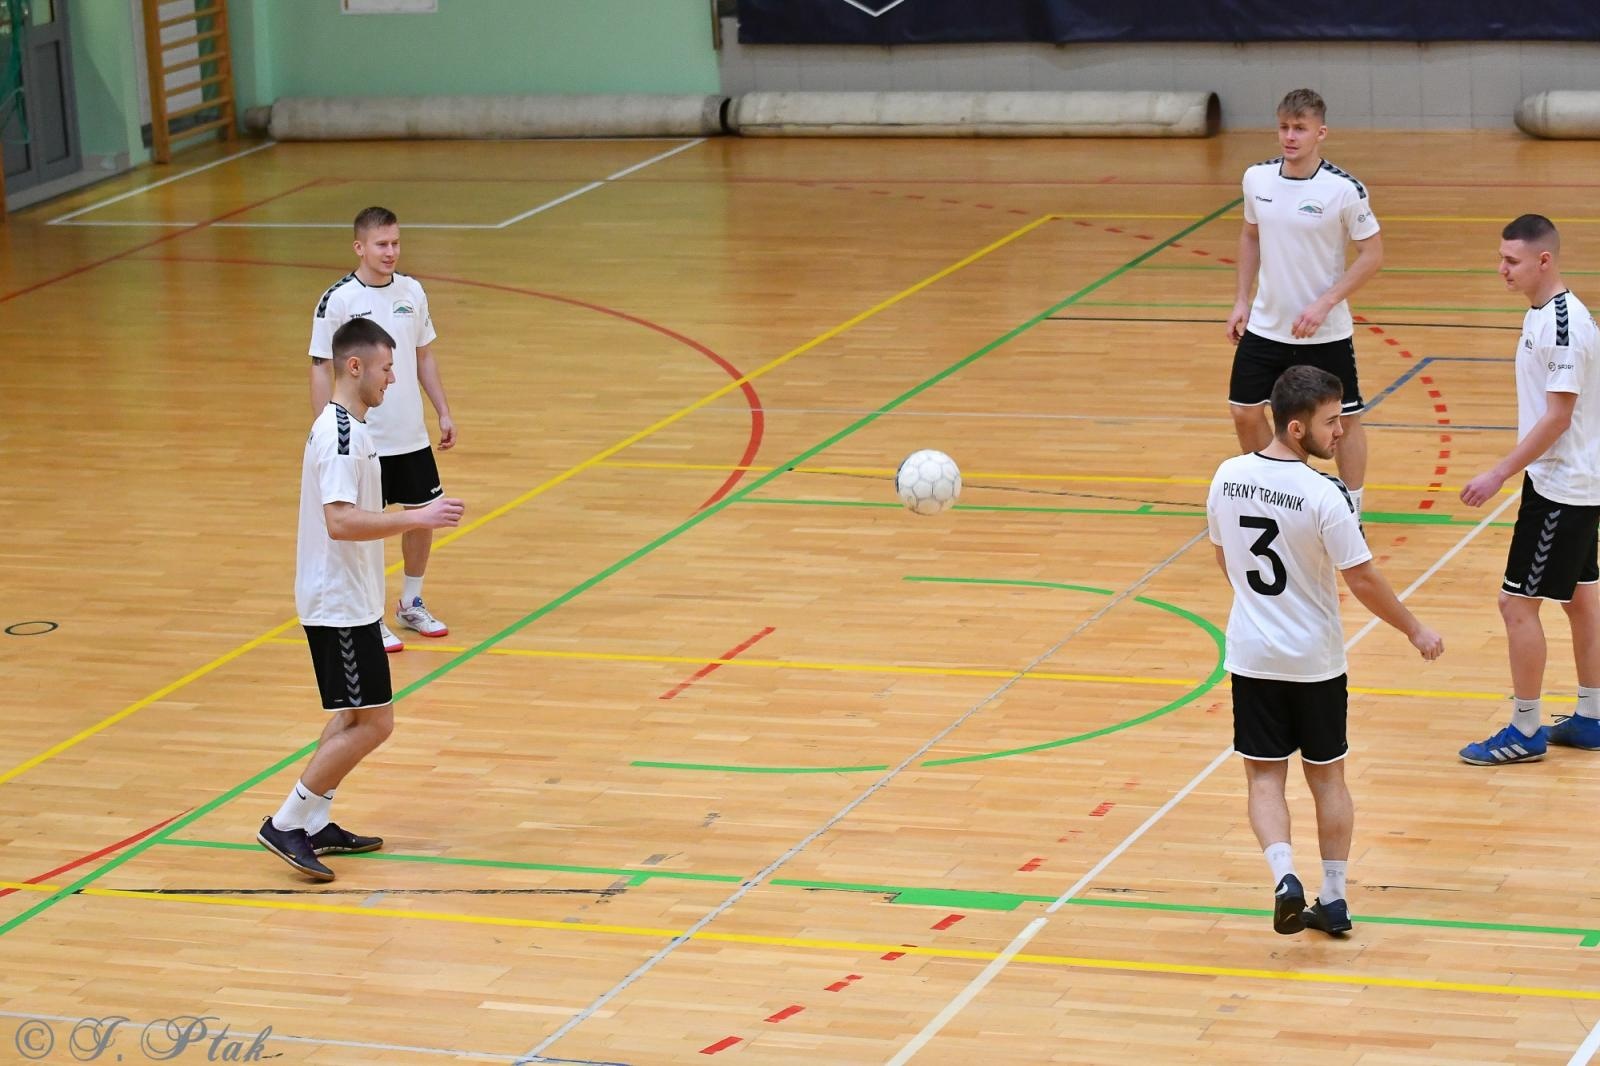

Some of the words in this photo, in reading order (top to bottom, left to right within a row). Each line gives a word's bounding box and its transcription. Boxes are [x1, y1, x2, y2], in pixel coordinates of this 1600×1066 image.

[1223, 482, 1257, 501] PIĘKNY
[1259, 487, 1305, 512] TRAWNIK
[1239, 515, 1287, 596] 3
